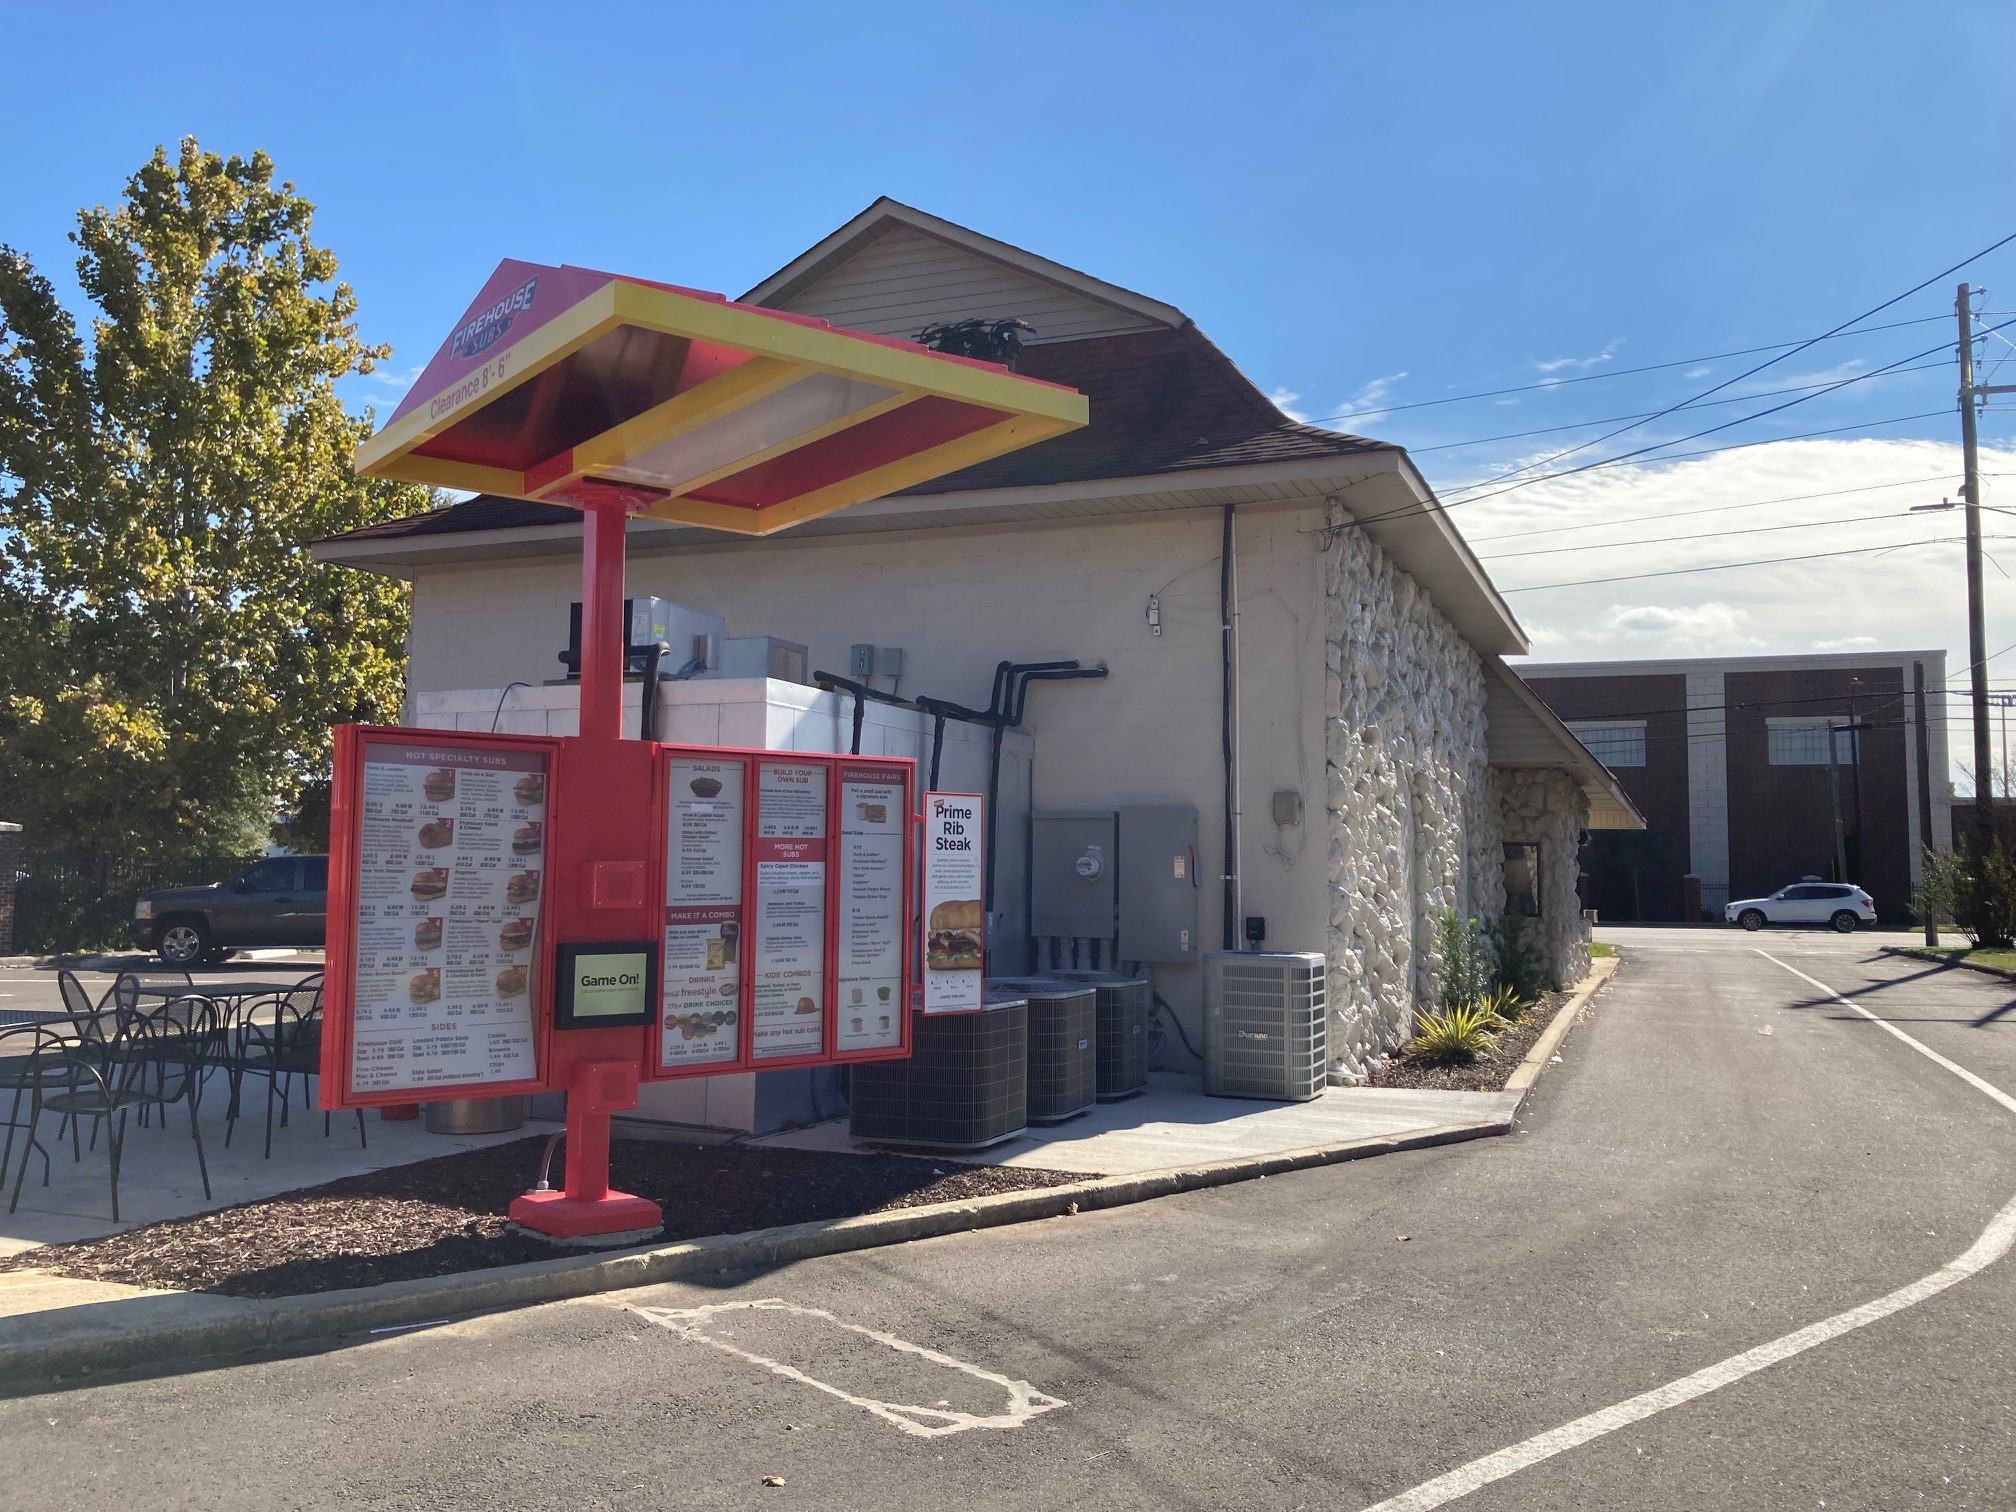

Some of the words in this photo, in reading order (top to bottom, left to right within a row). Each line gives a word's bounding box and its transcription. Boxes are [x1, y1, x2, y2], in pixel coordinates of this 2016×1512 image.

[451, 281, 535, 361] FIREHOUSE
[472, 323, 503, 353] SUBS
[430, 377, 480, 420] Clearance
[406, 751, 427, 760] HOT
[429, 752, 480, 764] SPECIALTY
[482, 756, 507, 765] SUBS
[692, 764, 721, 773] SALADS
[773, 768, 793, 776] BUILD
[794, 769, 813, 777] YOUR
[777, 776, 794, 784] OWN
[795, 776, 809, 784] SUB
[843, 771, 880, 780] FIREHOUSE
[936, 805, 972, 819] Prime
[943, 821, 965, 835] Rib
[774, 843, 794, 851] MORE
[935, 837, 972, 851] Steak
[670, 911, 692, 920] MAKE
[693, 911, 701, 919] IT
[701, 911, 708, 919] A
[708, 910, 735, 919] COMBO
[783, 969, 812, 978] COMBOS
[581, 975, 617, 987] Game
[618, 973, 640, 985] On!
[688, 975, 716, 984] DRINKS
[681, 986, 717, 999] freestyle
[667, 1002, 682, 1010] 175+
[683, 1001, 704, 1009] DRINK
[705, 999, 734, 1007] CHOICES
[431, 1022, 458, 1032] SIDES
[782, 1027, 794, 1035] hot
[794, 1026, 806, 1034] sub
[488, 1046, 511, 1054] Brownie
[356, 1065, 394, 1073] Five-Cheese
[375, 1071, 398, 1079] Cheese
